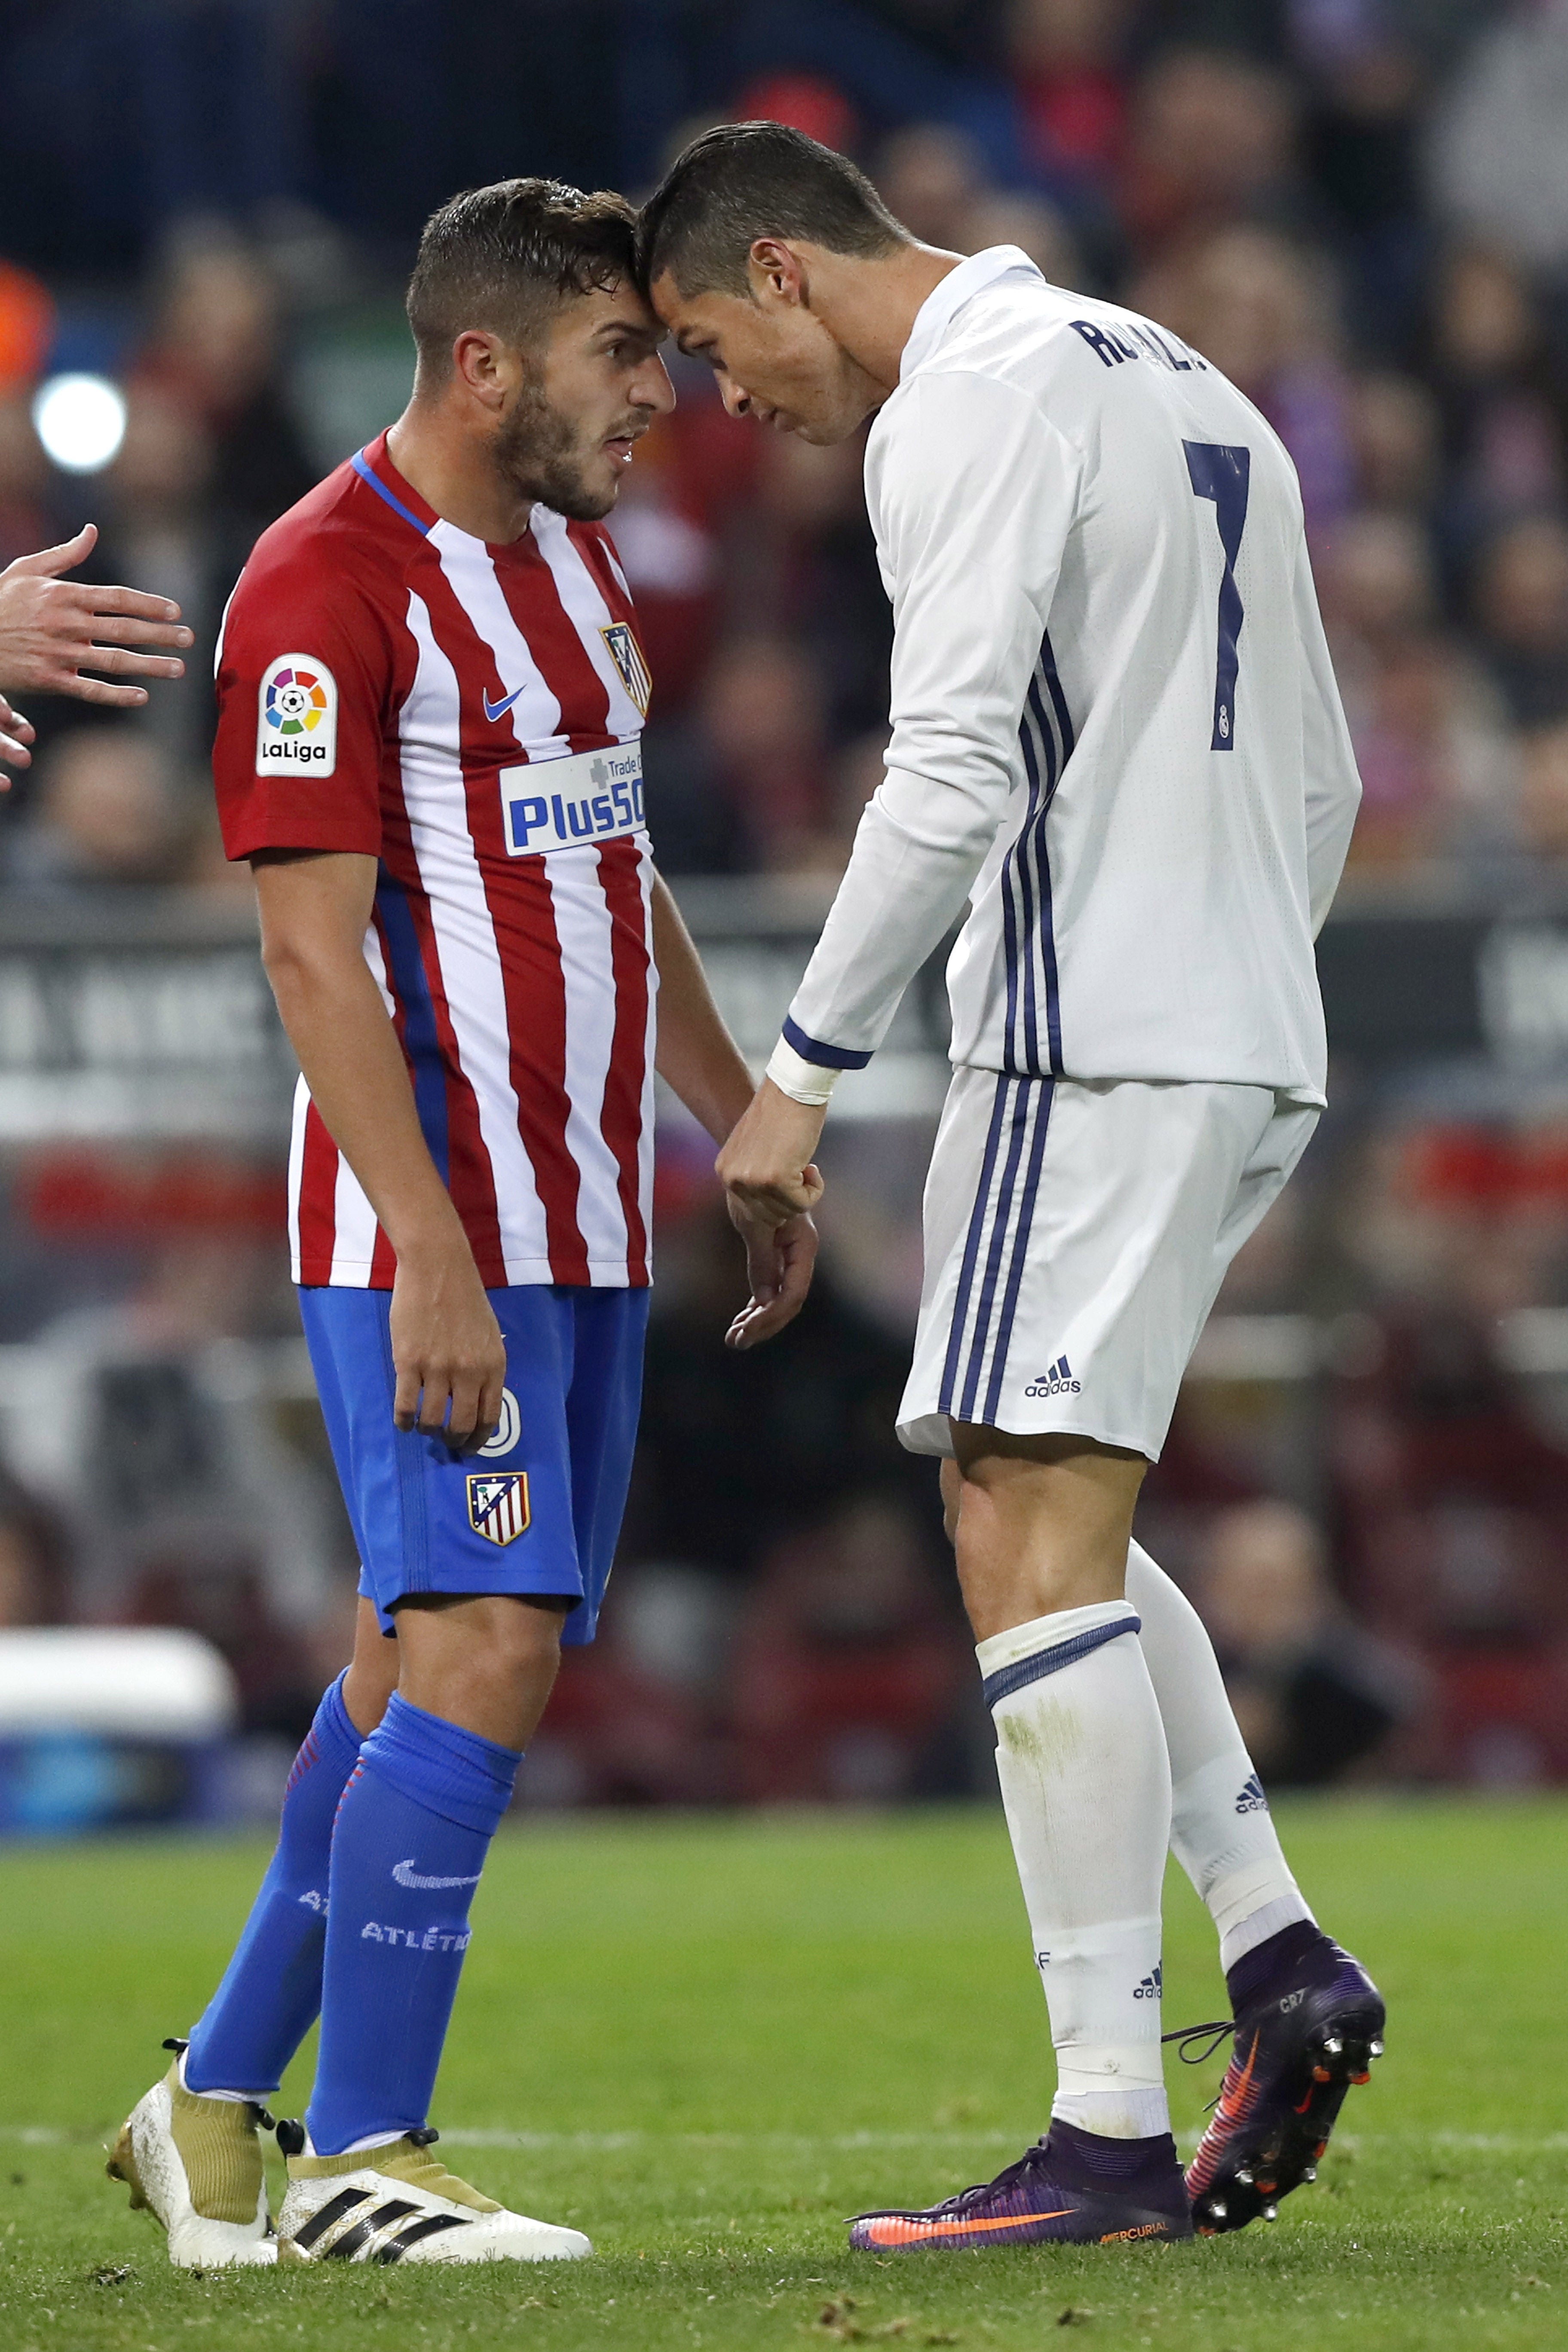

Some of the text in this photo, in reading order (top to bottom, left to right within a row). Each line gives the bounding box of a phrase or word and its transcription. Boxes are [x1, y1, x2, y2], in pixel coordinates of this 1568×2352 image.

[1182, 438, 1250, 751] 7
[263, 741, 325, 763] LaLiga
[608, 756, 637, 777] Trade
[1025, 1378, 1081, 1397] adidas
[1279, 1987, 1307, 2013] CR7
